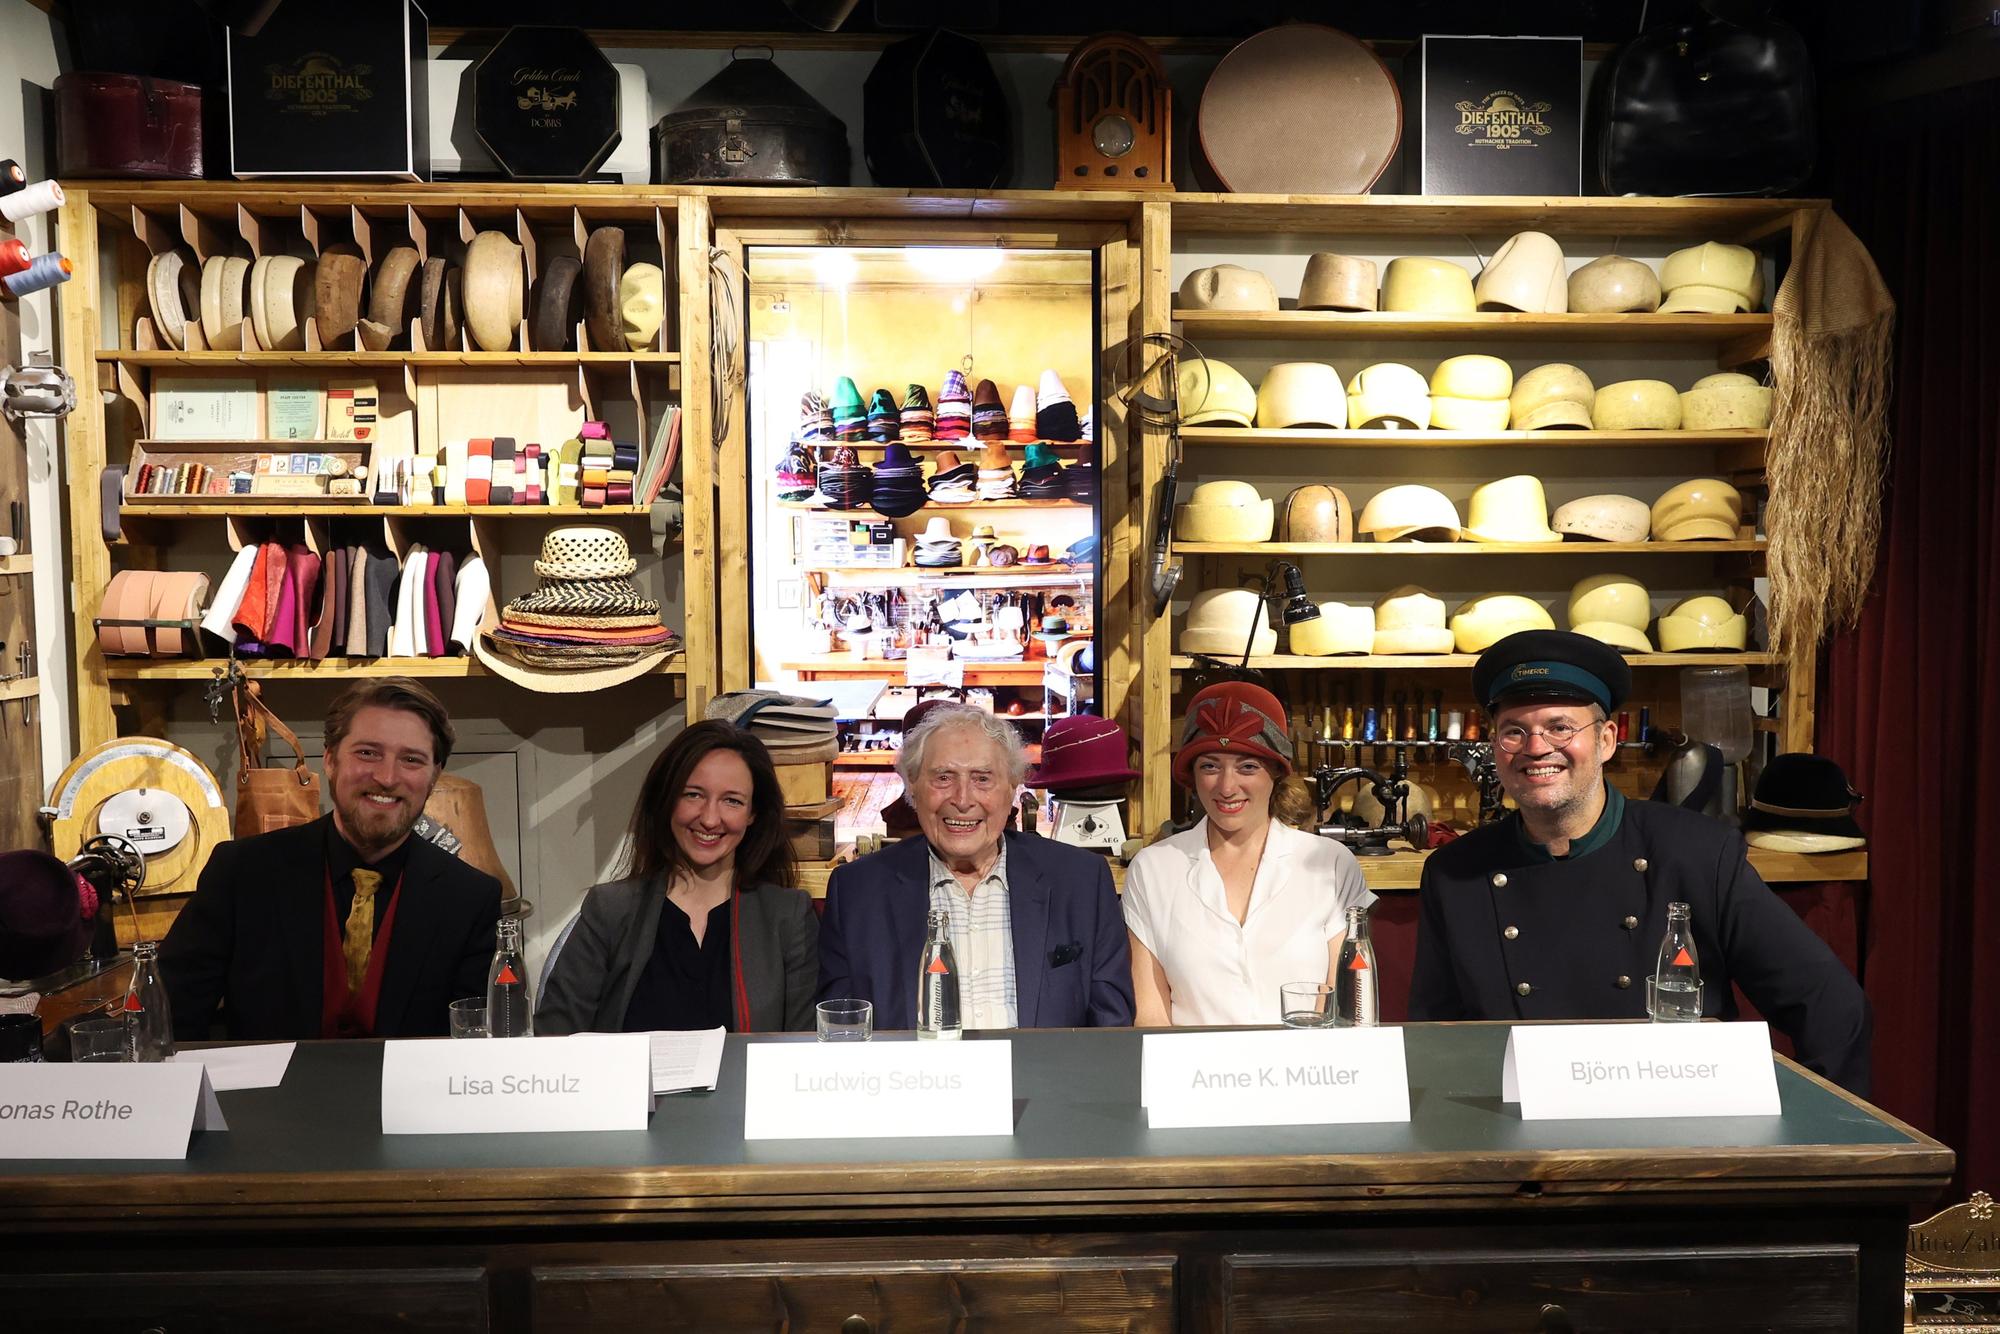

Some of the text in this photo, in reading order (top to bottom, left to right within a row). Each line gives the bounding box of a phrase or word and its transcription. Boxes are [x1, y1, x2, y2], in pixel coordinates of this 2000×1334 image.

[271, 75, 364, 89] DIEFENTHAL
[511, 67, 581, 86] Golden Coach
[299, 89, 337, 104] 1905
[1461, 111, 1544, 125] DIEFENTHAL
[1486, 125, 1520, 138] 1905
[933, 980, 942, 1027] Apollinaris
[1192, 1065, 1359, 1088] Anne K. Müller
[1570, 1060, 1719, 1085] Björn Heuser
[448, 1074, 580, 1096] Lisa Schulz
[794, 1070, 962, 1097] Ludwig Sebus
[0, 1099, 133, 1120] onas Rothe
